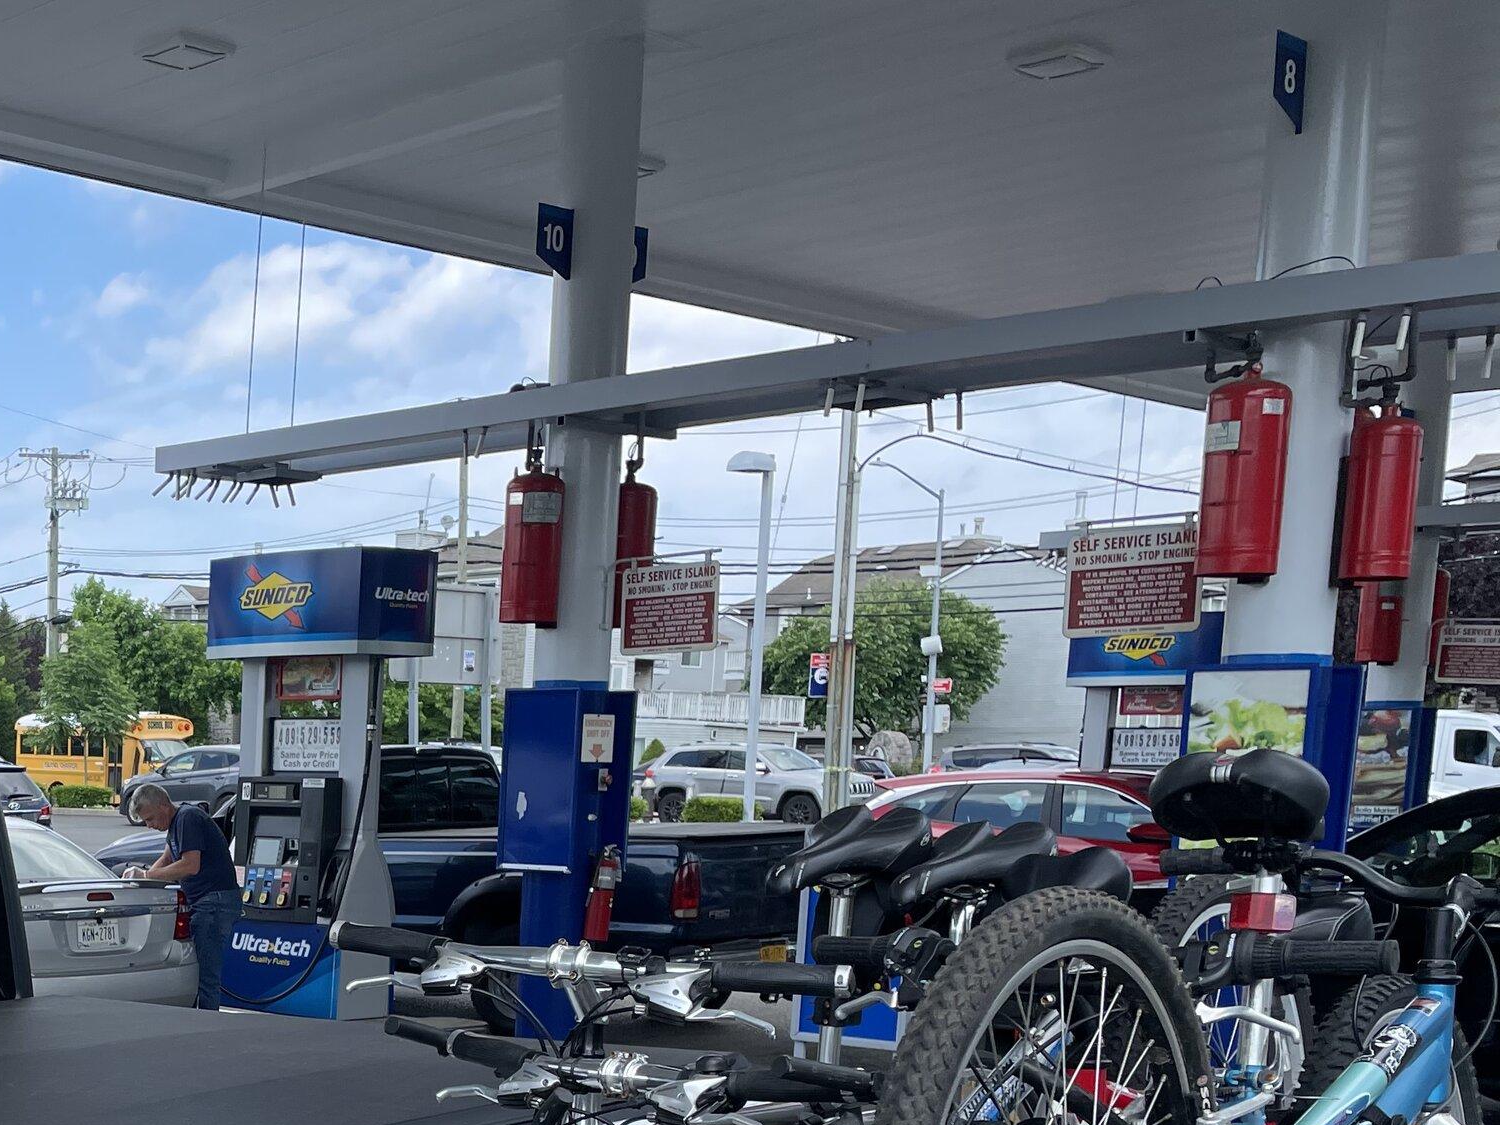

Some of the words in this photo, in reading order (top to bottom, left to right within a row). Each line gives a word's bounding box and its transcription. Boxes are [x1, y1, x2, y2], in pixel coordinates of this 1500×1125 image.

[1284, 59, 1297, 94] 8
[543, 223, 565, 252] 10
[1073, 539, 1099, 552] SELF
[1104, 534, 1151, 550] SERVICE
[1075, 556, 1086, 566] NO
[1090, 553, 1127, 564] SMOKING
[1138, 550, 1160, 561] STOP
[1164, 548, 1195, 558] ENGINE
[627, 573, 645, 584] SELF
[649, 569, 682, 581] SERVICE
[685, 566, 716, 578] ISLAND
[243, 586, 308, 607] SUNOCO
[628, 587, 636, 595] NO
[639, 585, 665, 594] SMOKING
[673, 582, 688, 591] STOP
[691, 580, 713, 589] ENGINE
[1107, 637, 1172, 650] SUNOCO
[280, 751, 300, 759] Same
[302, 751, 317, 759] Low
[319, 751, 338, 759] Price
[283, 760, 301, 768] Cash
[312, 760, 335, 768] Credit
[249, 955, 269, 965] Quality
[271, 956, 290, 966] Fuels
